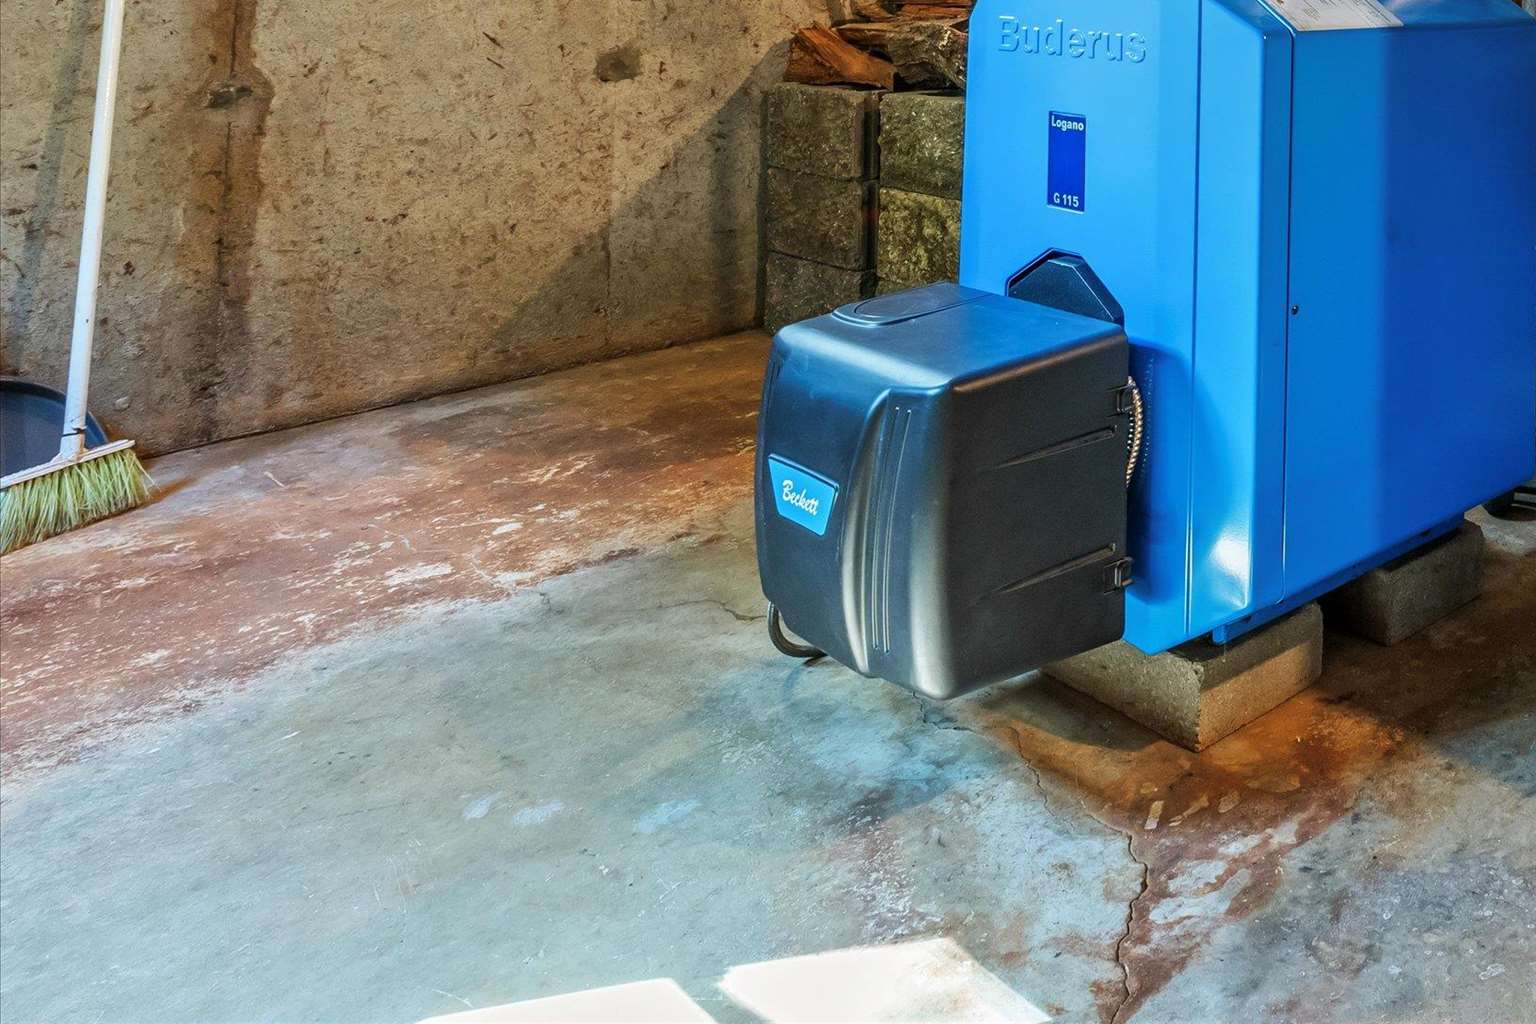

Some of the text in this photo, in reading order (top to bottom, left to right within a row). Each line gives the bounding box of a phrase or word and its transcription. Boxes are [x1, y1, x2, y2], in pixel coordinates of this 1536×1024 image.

[998, 15, 1147, 64] Buderus
[1051, 115, 1084, 132] Logano
[1053, 192, 1079, 207] G 115
[782, 479, 819, 516] Beckett
